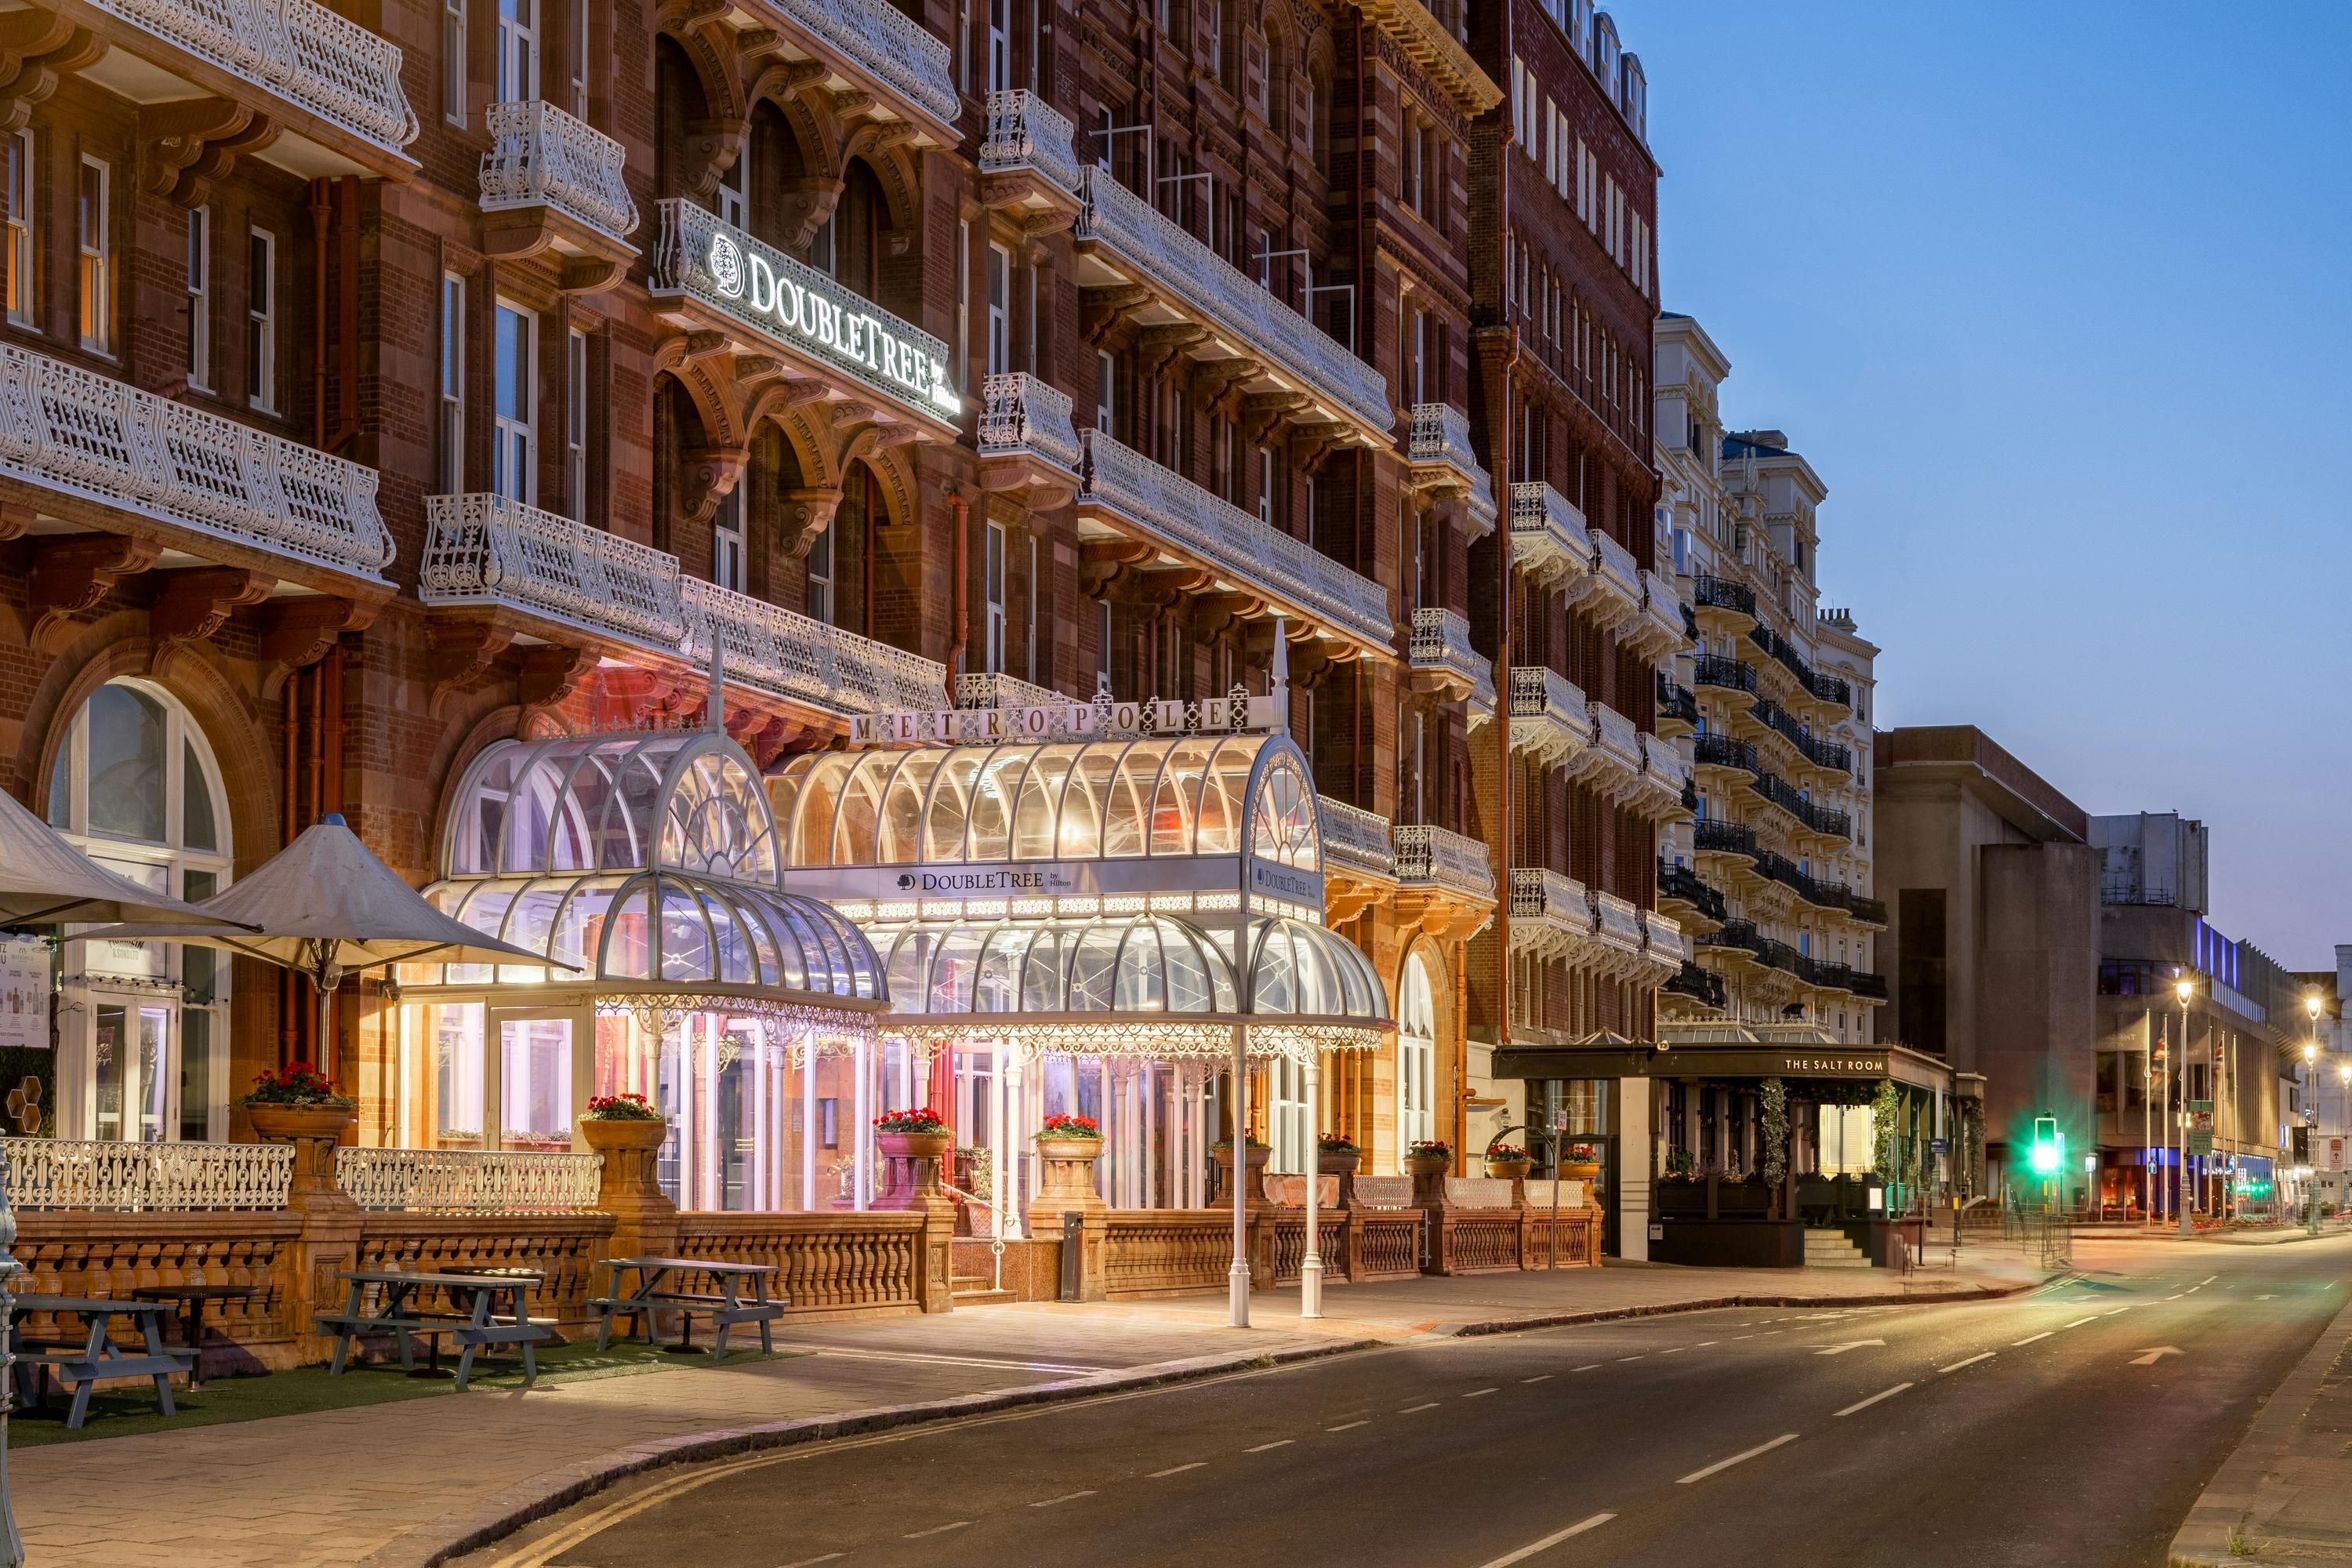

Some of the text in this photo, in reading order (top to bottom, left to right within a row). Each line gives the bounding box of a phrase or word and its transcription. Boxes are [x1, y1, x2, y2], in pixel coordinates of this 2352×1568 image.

[931, 358, 944, 385] by
[931, 383, 961, 414] Hilton
[855, 702, 1222, 739] METROPOLE
[117, 949, 130, 959] SONS
[130, 949, 139, 960] LTD
[1785, 1060, 1883, 1071] THE SALT ROOM
[1553, 1102, 1599, 1113] SALT
